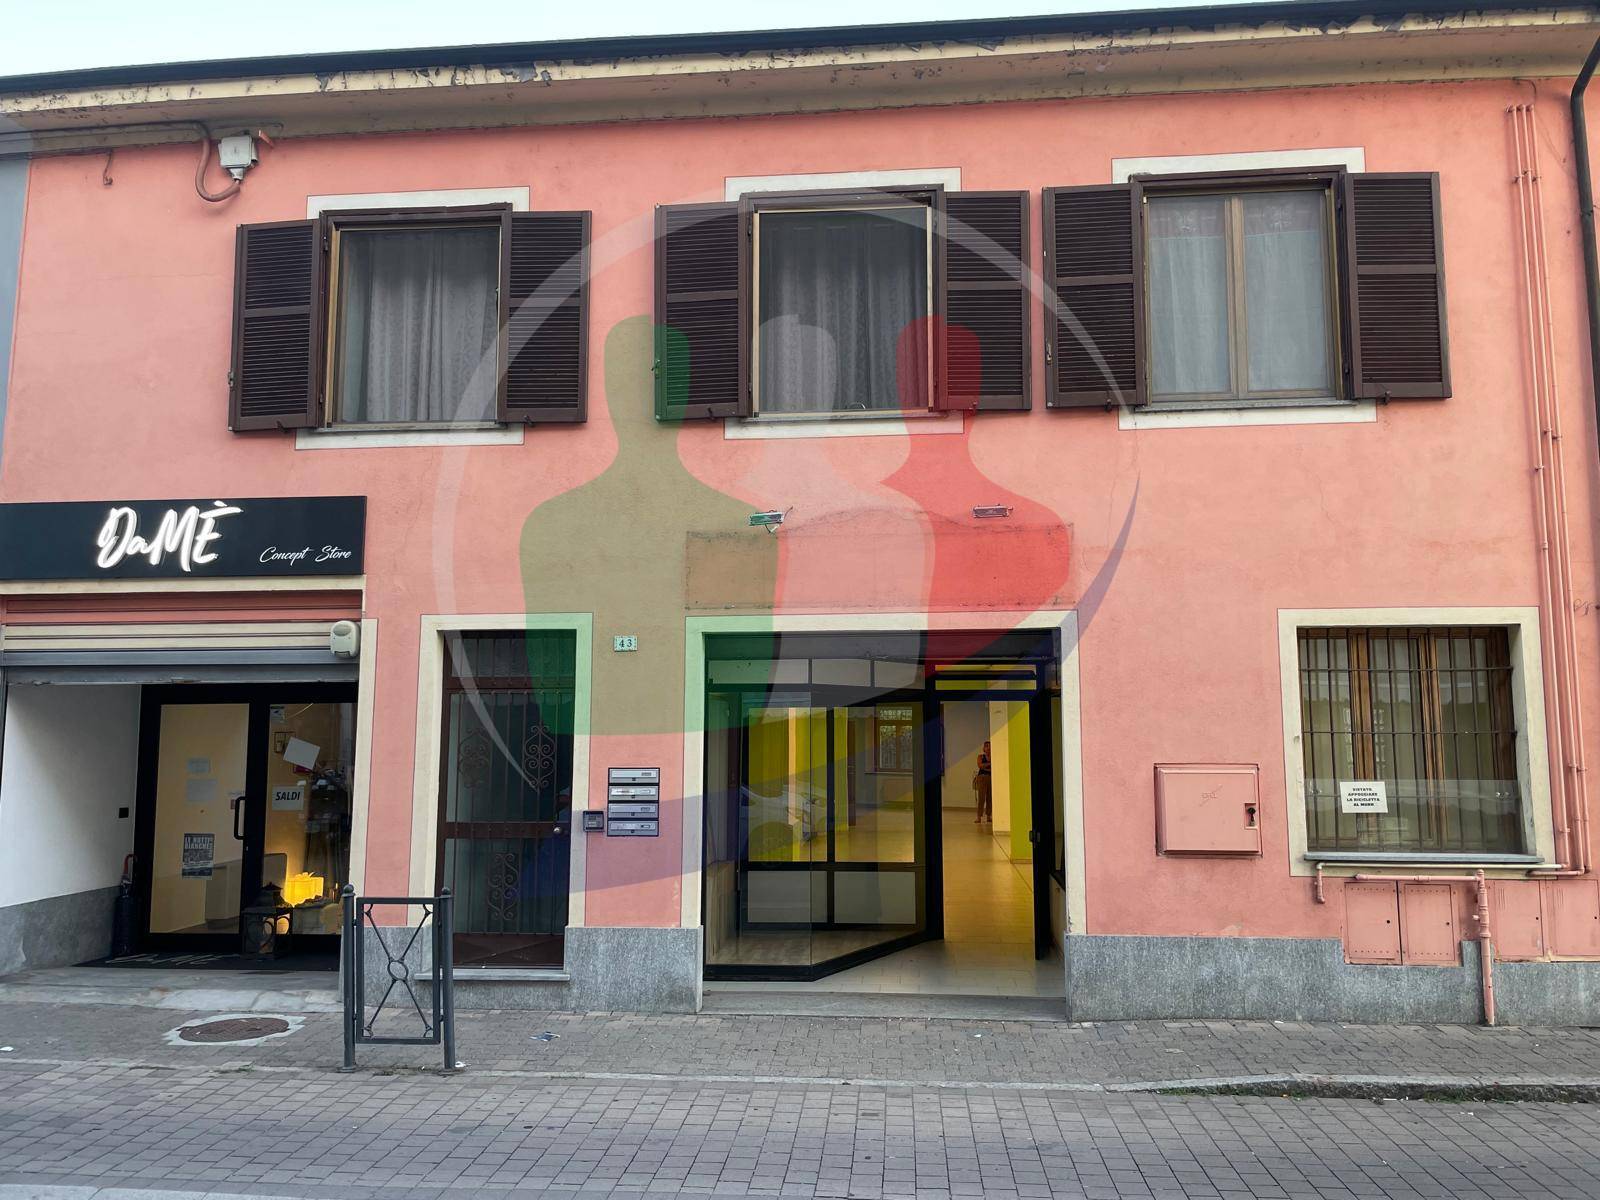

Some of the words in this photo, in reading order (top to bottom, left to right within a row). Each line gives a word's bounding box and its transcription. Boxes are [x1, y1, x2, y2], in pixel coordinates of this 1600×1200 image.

[259, 546, 315, 567] Concept
[315, 545, 352, 562] Store
[618, 638, 633, 648] 43
[275, 791, 301, 801] SALDI
